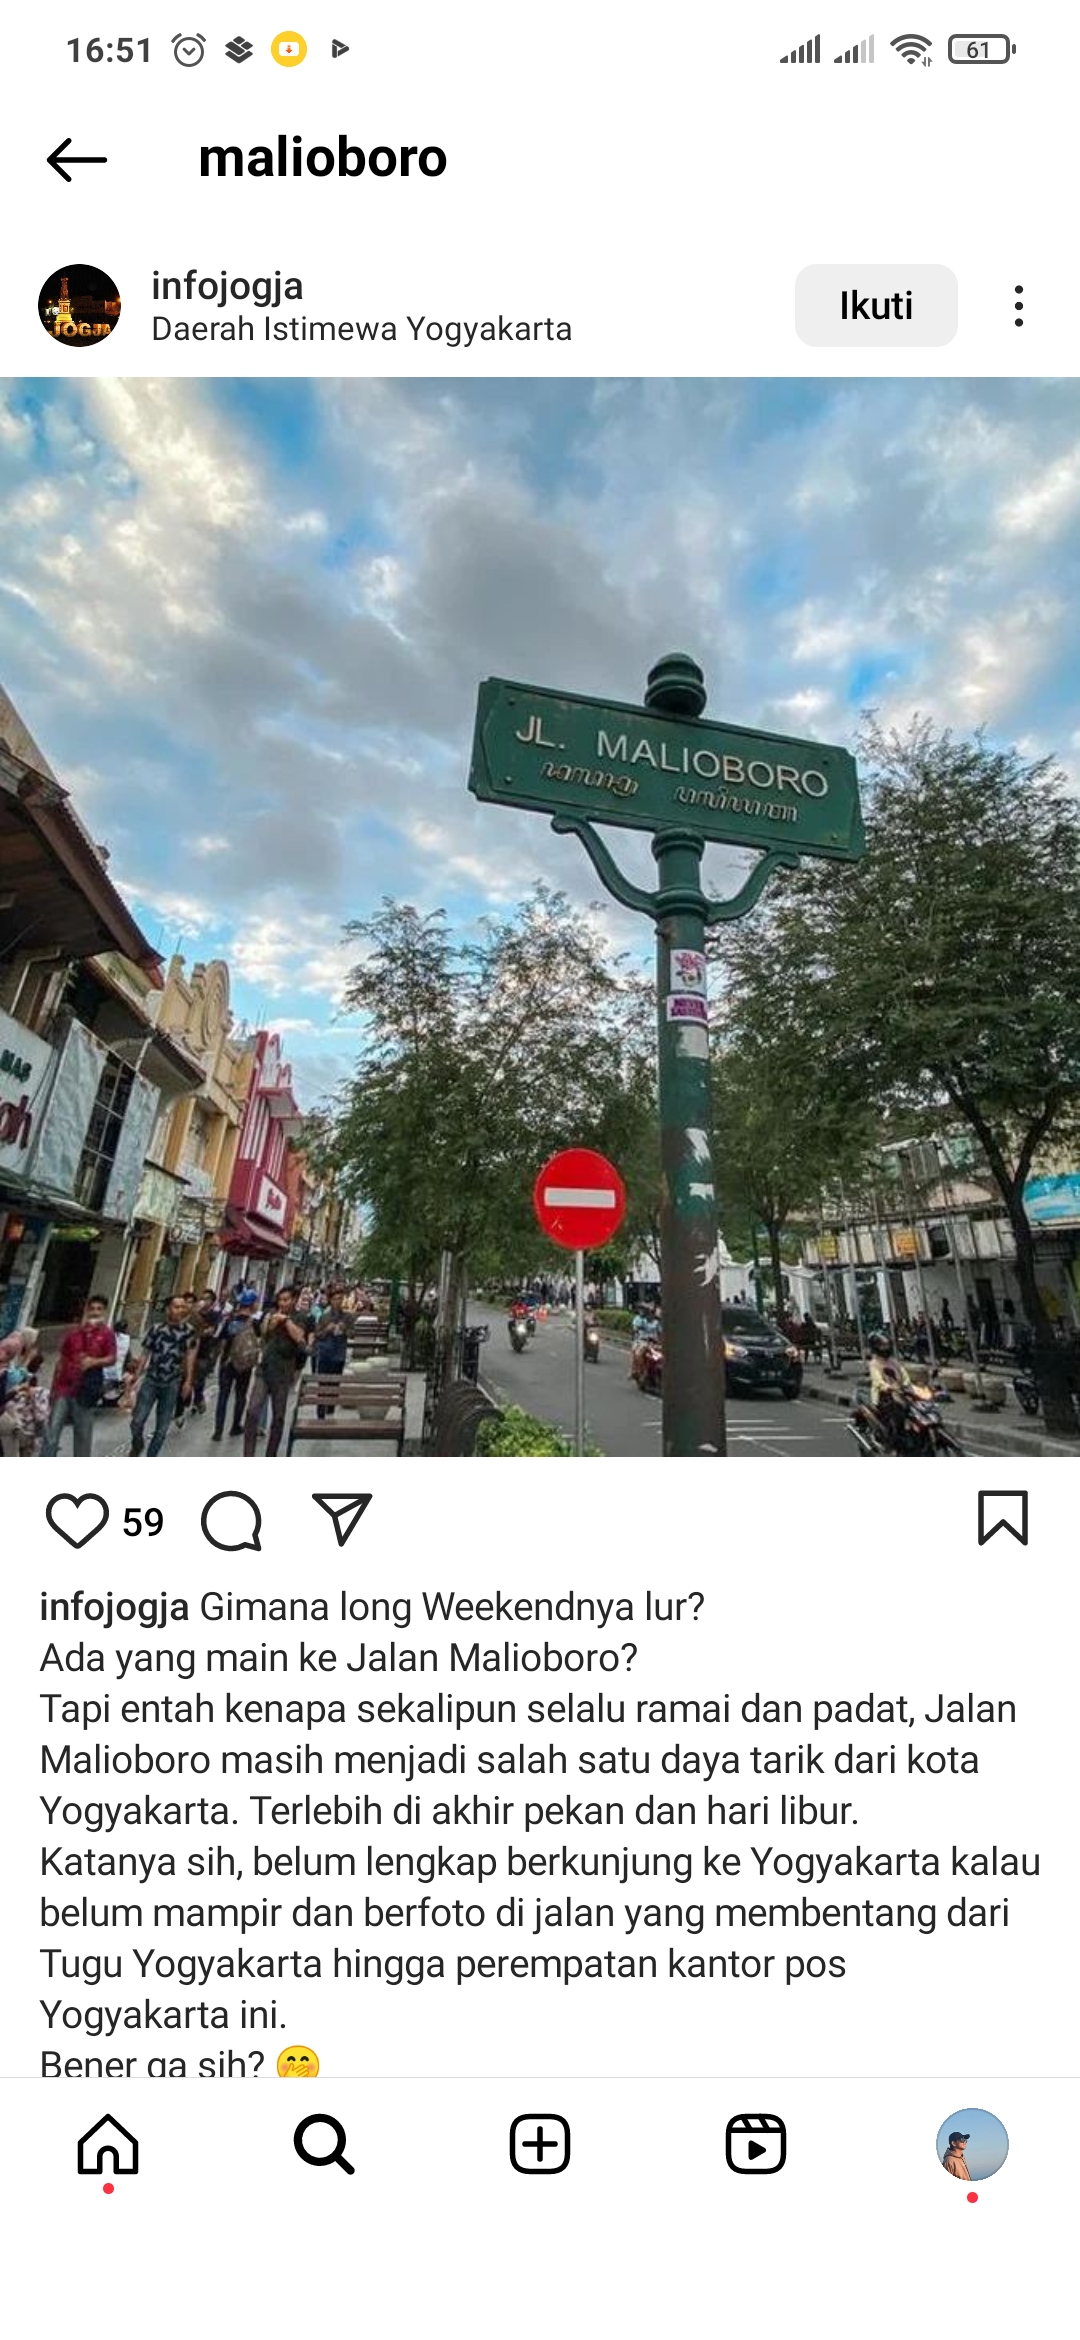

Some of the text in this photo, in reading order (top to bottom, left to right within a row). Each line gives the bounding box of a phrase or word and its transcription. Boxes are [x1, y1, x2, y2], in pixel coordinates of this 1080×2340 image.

[68, 38, 148, 62] 16:51
[966, 41, 989, 59] 61
[200, 134, 447, 178] malioboro
[152, 268, 303, 305] infojogja
[841, 289, 913, 320] Ikuti
[154, 315, 571, 346] Daerah Istimewa Yogyakarta
[516, 715, 829, 797] JL. MALIOBORO
[123, 1507, 164, 1537] 59
[41, 1590, 704, 1628] infojogja Gimana long Weekendnya lur?
[40, 1642, 637, 1679] Ada yang main ke Jalan Malioboro?
[40, 1693, 1015, 1730] Tapi entah kenapa sekalipun selalu ramai dan padat, Jalan
[42, 1744, 978, 1781] Malioboro masih menjadi salah satu daya tarik dari kota
[40, 1795, 857, 1832] Yogyakarta. Terlebih di akhir pekan dan hari libur.
[42, 1846, 1039, 1883] Katanya sih, belum lengkap berkunjung ke Yogyakarta kalau
[42, 1896, 1008, 1934] belum mampir dan berfoto di jalan yang membentang dari
[40, 1948, 845, 1985] Tugu Yogyakarta hingga perempatan kantor pos
[40, 1999, 285, 2036] Yogyakarta ini.
[41, 2050, 138, 2077] Bener
[198, 2049, 265, 2077] sih?
